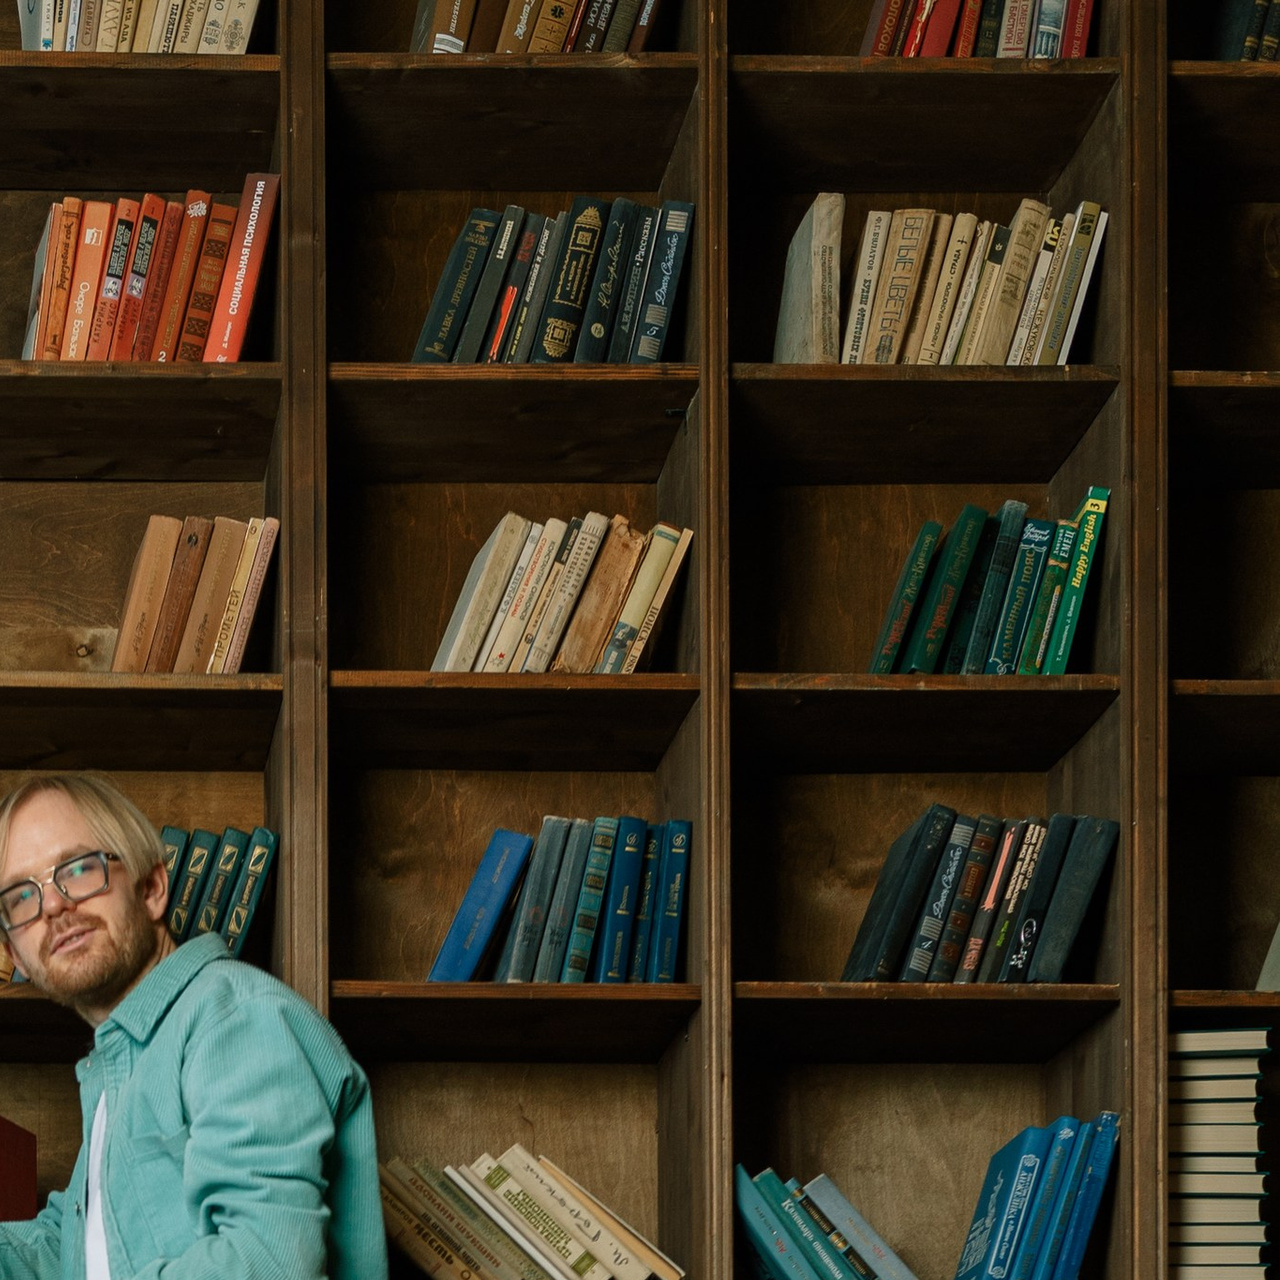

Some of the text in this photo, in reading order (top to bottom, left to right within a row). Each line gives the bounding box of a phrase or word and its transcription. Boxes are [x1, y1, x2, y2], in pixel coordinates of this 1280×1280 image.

[228, 181, 266, 315] СОЦИАЛЬНАЯ ПСИХОЛОГИЯ
[1059, 530, 1076, 558] ЕМЕЦ
[1071, 513, 1098, 588] Happy English
[1002, 549, 1036, 659] КАМЕННЫЙ ПОЯС
